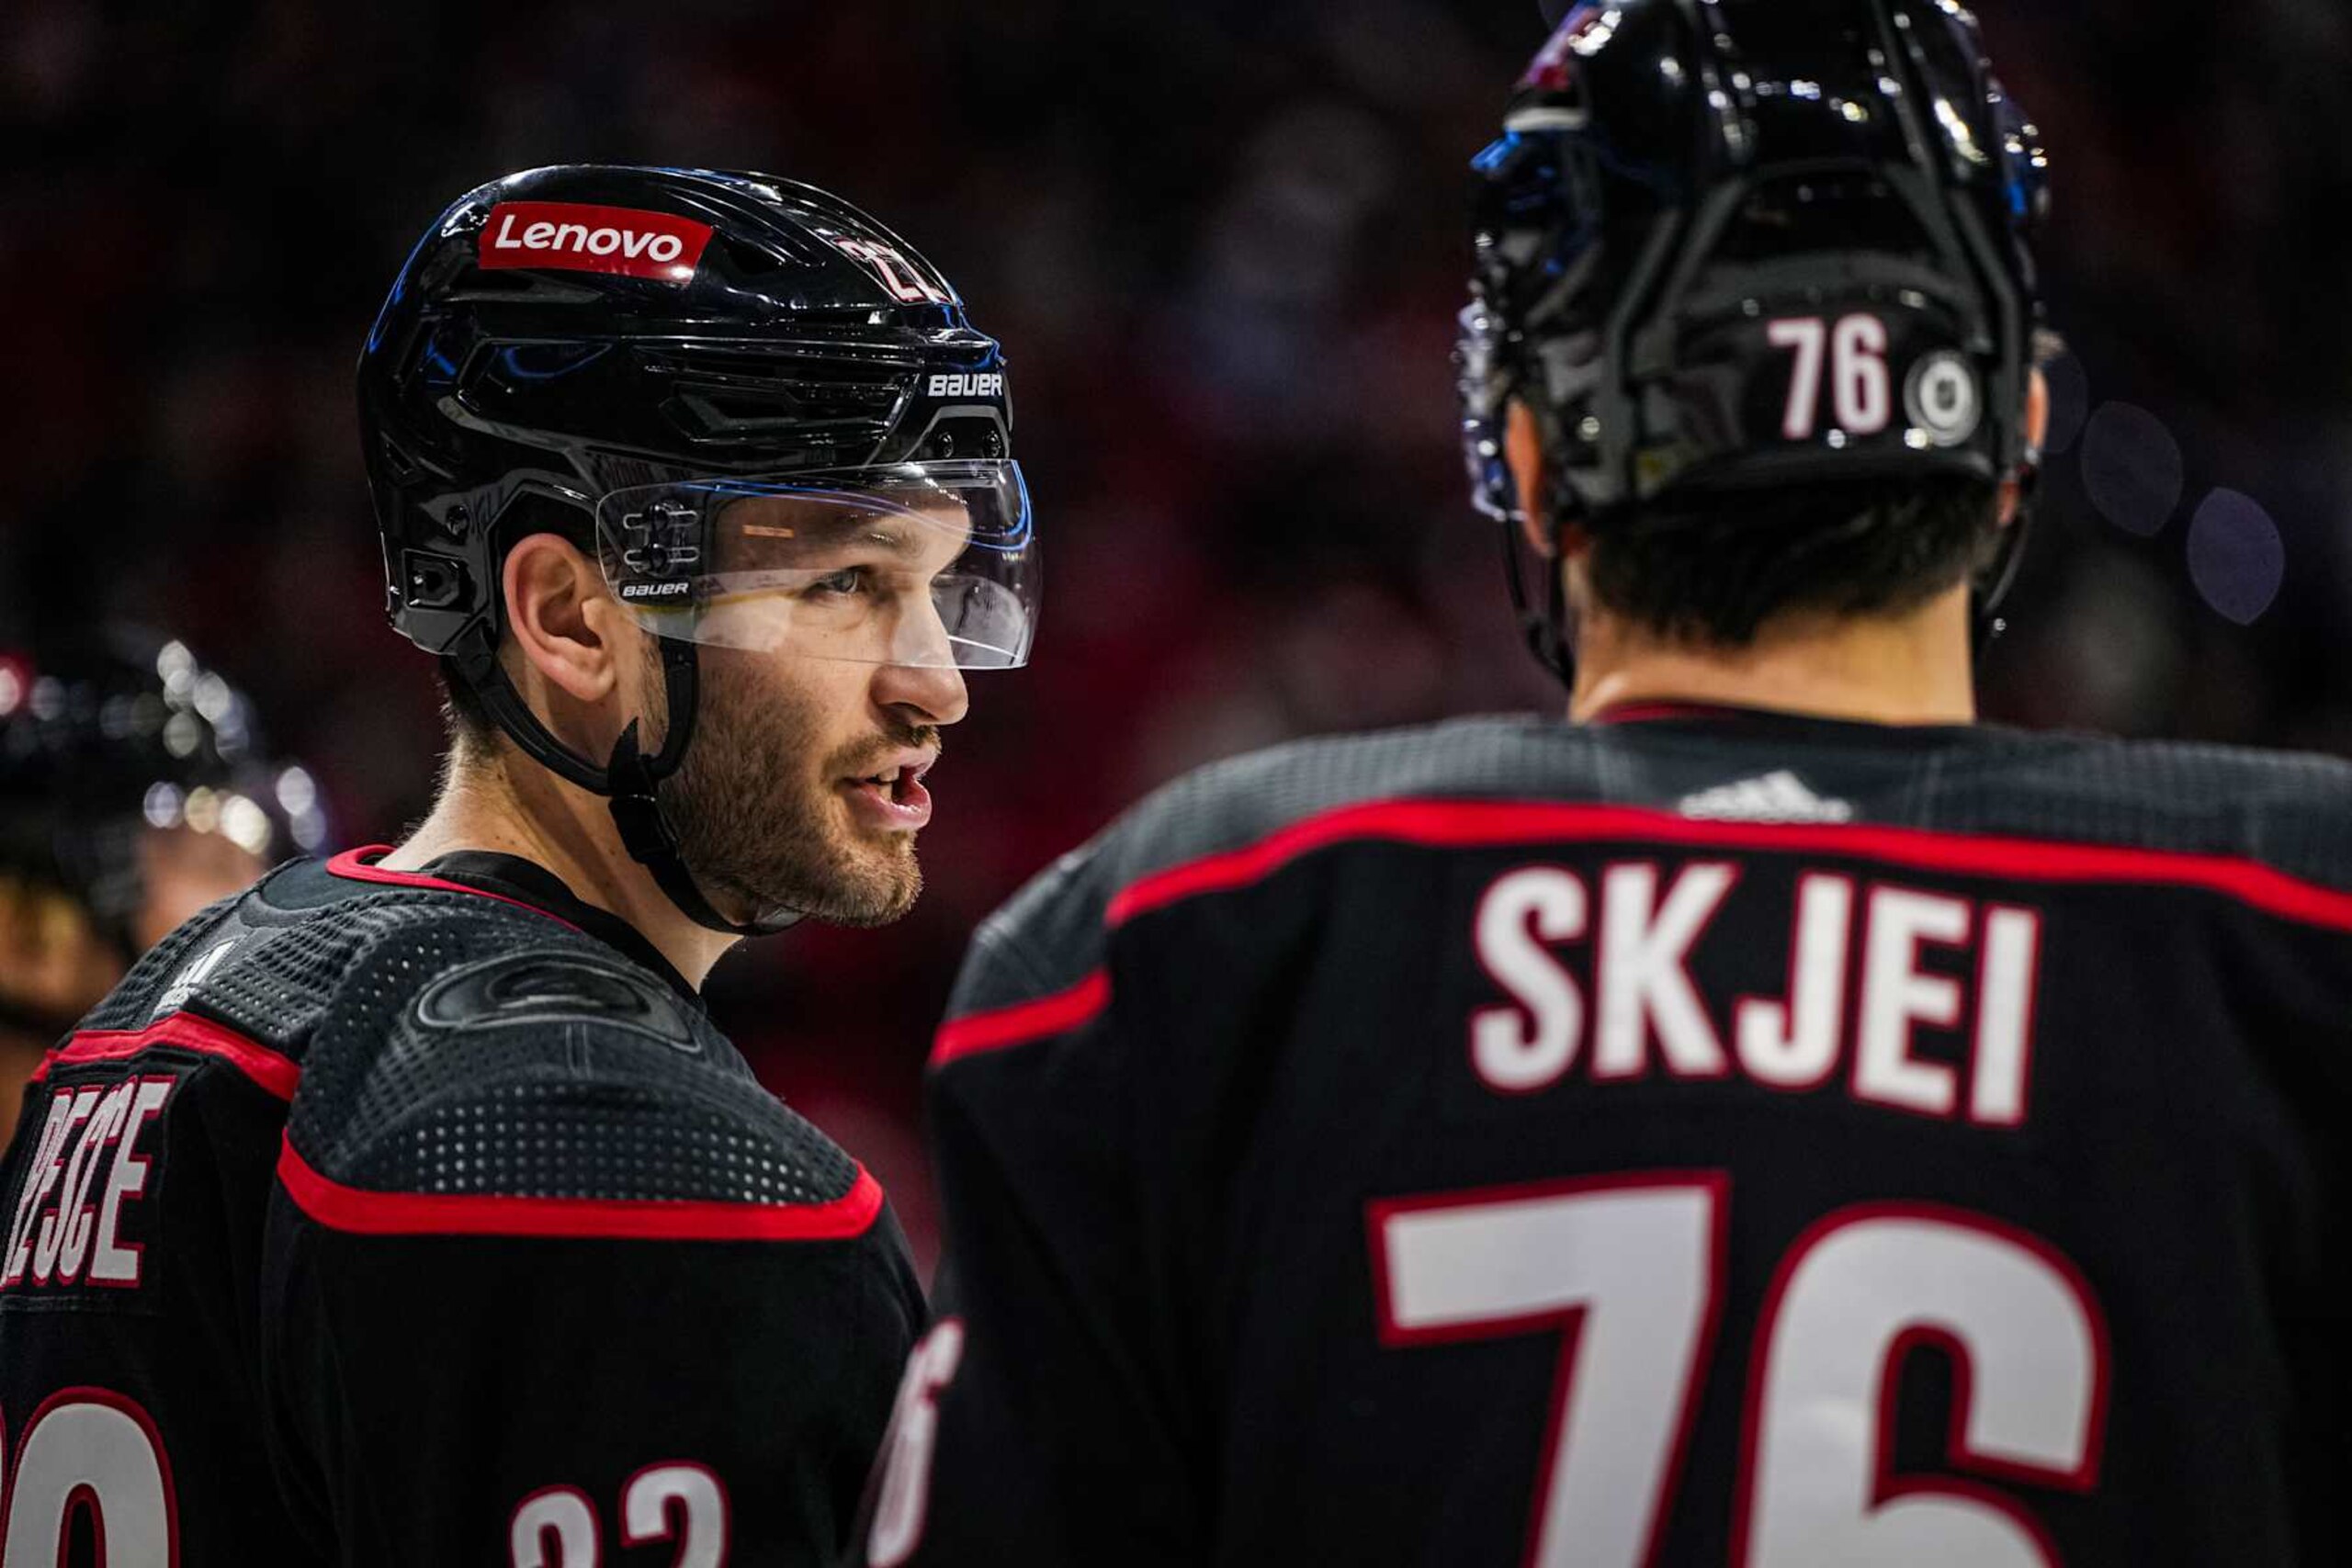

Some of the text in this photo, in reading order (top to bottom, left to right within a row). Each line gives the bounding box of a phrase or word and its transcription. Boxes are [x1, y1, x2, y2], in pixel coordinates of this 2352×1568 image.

[495, 214, 683, 262] Lenovo
[928, 374, 1002, 397] BAUER
[1767, 312, 1891, 439] 76
[622, 582, 689, 597] BAUER
[1470, 860, 2043, 1128] SKJEI
[0, 1075, 177, 1289] PESCE
[1365, 1168, 2111, 1568] 76
